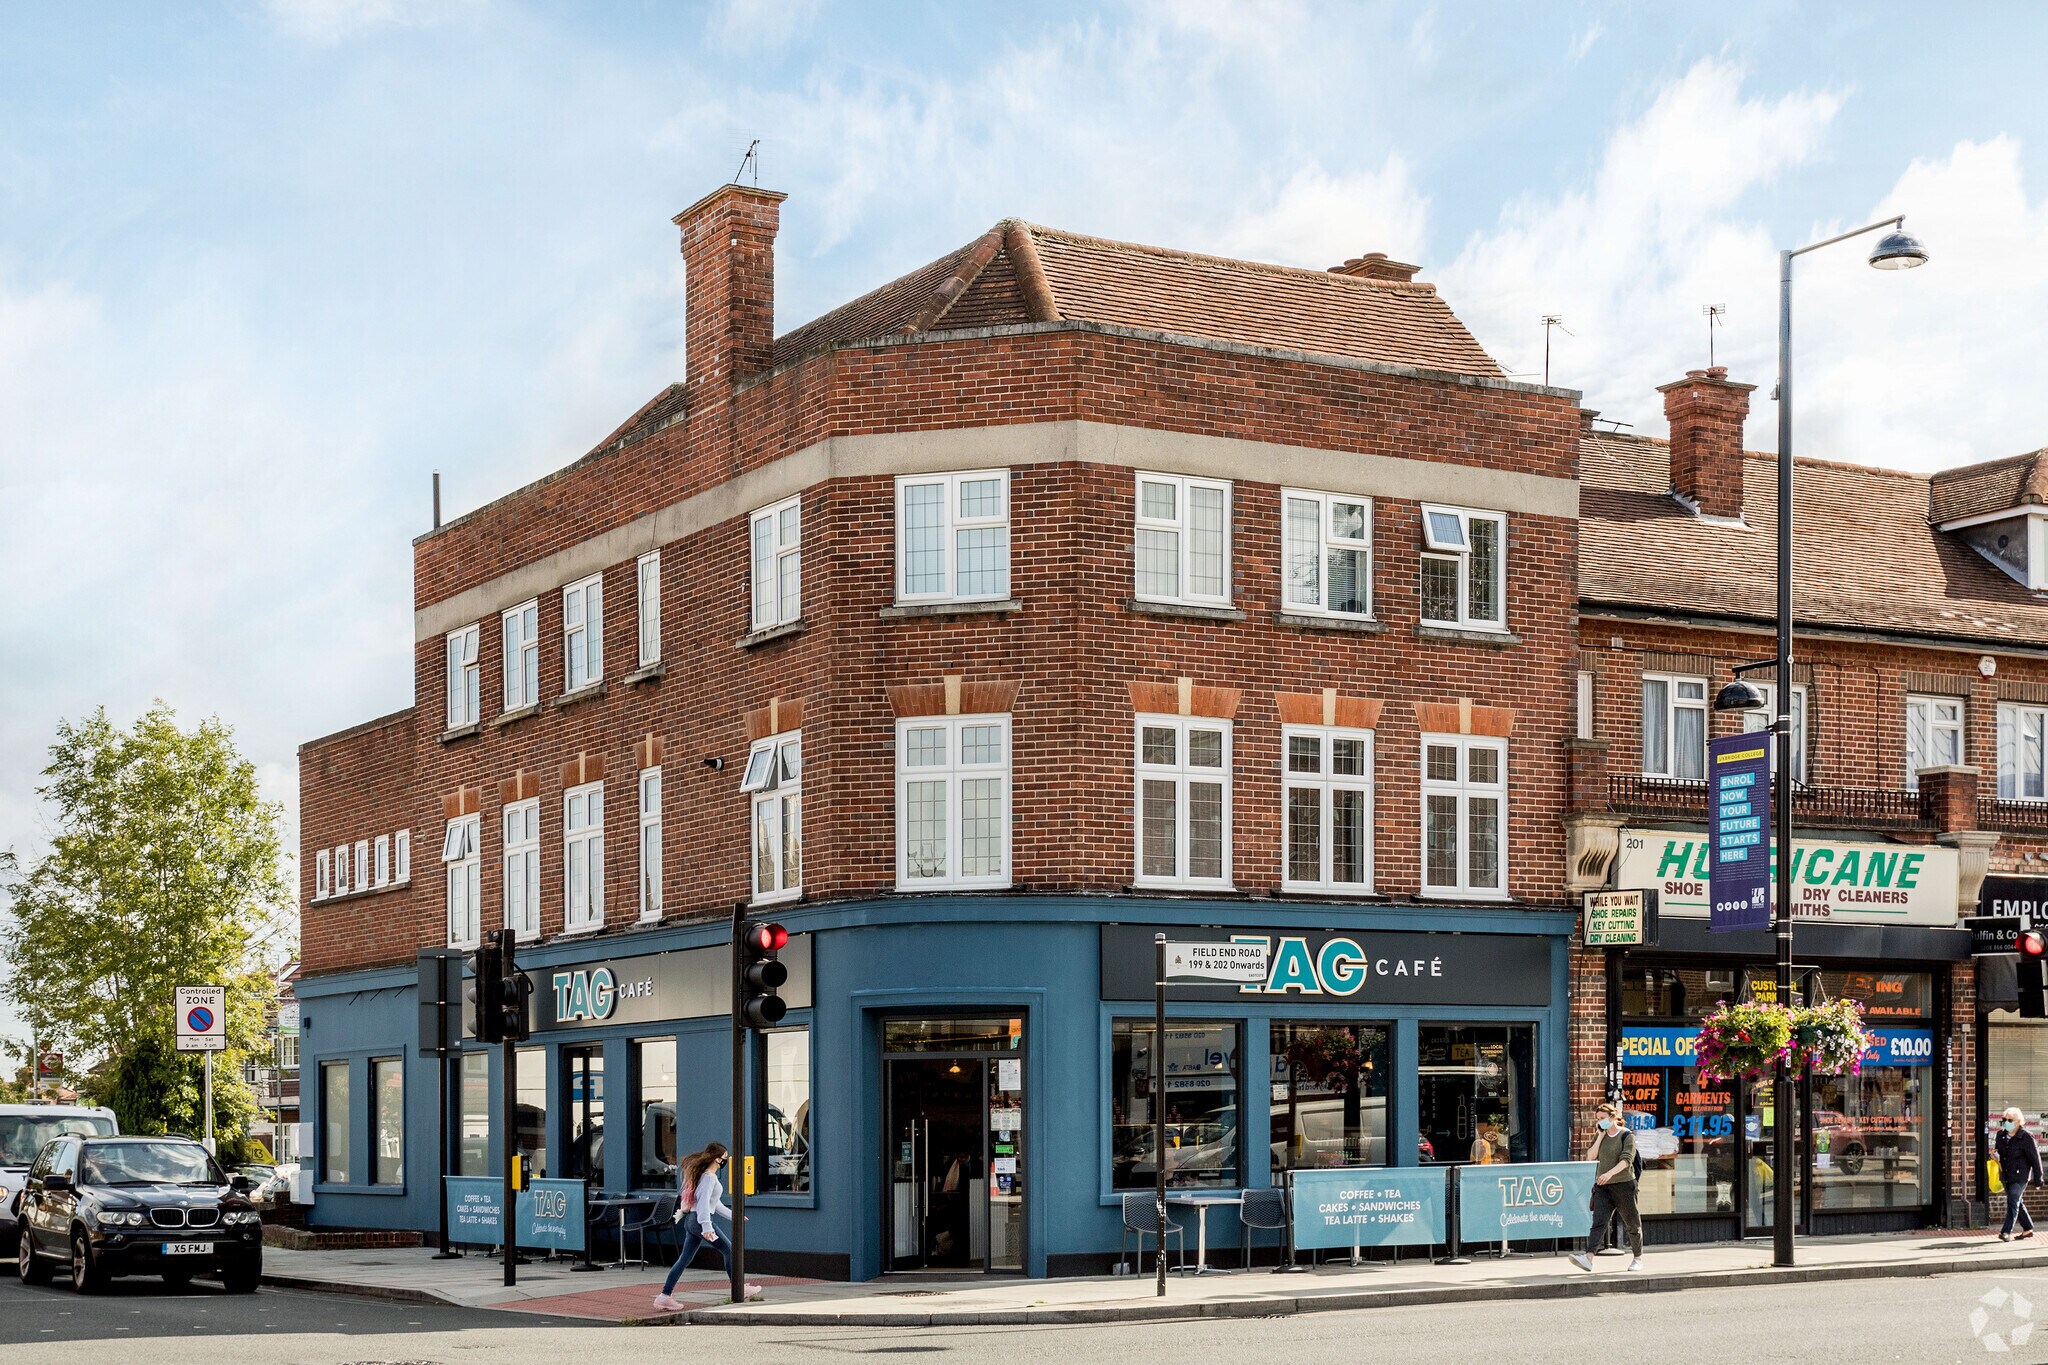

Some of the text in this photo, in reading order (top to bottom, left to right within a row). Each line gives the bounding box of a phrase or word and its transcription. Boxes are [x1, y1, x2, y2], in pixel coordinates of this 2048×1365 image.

[1741, 750, 1762, 759] COLLEGE
[1721, 775, 1752, 787] ENROL
[1721, 791, 1744, 802] NOW
[1721, 805, 1748, 816] YOUR
[1721, 819, 1757, 831] FUTURE
[1626, 839, 1644, 849] 201
[1721, 834, 1758, 846] STARTS
[1721, 850, 1744, 860] HERE
[1657, 841, 1925, 888] HUICANE
[1664, 882, 1703, 896] SHOE
[1590, 895, 1639, 907] WHILE YOU WAIT
[1803, 888, 1908, 904] DRY CLEANERS
[1591, 908, 1637, 919] SHOE REPAIRS
[1593, 920, 1634, 930] KEY CUTTING
[1590, 933, 1636, 943] DRY CLEANING
[1996, 930, 2004, 940] &
[2006, 930, 2018, 940] Co
[1193, 948, 1261, 957] FIELD END ROAD
[1188, 960, 1265, 970] 199 & 202 Onwards
[1375, 956, 1442, 977] CAFÉ
[553, 967, 653, 1022] TAG CAFÉ
[1869, 1007, 1921, 1016] AVAILABLE
[1622, 1037, 1670, 1055] PECIAL
[1890, 1038, 1932, 1056] £10.00
[1455, 1048, 1469, 1057] TEA
[1865, 1049, 1880, 1062] Only
[1623, 1073, 1660, 1085] RTAINS
[1696, 1069, 1708, 1089] 4
[1635, 1088, 1659, 1100] OFF
[1676, 1092, 1731, 1105] GARMENTS
[1635, 1103, 1657, 1111] DUVETS
[1672, 1114, 1733, 1137] £11.95
[1340, 1189, 1401, 1200] COFFEE TEA
[1498, 1175, 1564, 1207] TAG
[464, 1194, 492, 1203] COFFEE TEA
[534, 1190, 567, 1218] TAG
[456, 1205, 500, 1215] CAKES SANDWICHES
[1319, 1201, 1421, 1213] CAKES SANDWICHES
[466, 1216, 478, 1224] LATTE
[481, 1216, 498, 1225] SHAKES
[1325, 1213, 1414, 1225] TEA LATTE SHAKES
[1500, 1210, 1563, 1228] Celebrate the everyday
[174, 1244, 206, 1253] X5 FMJ
